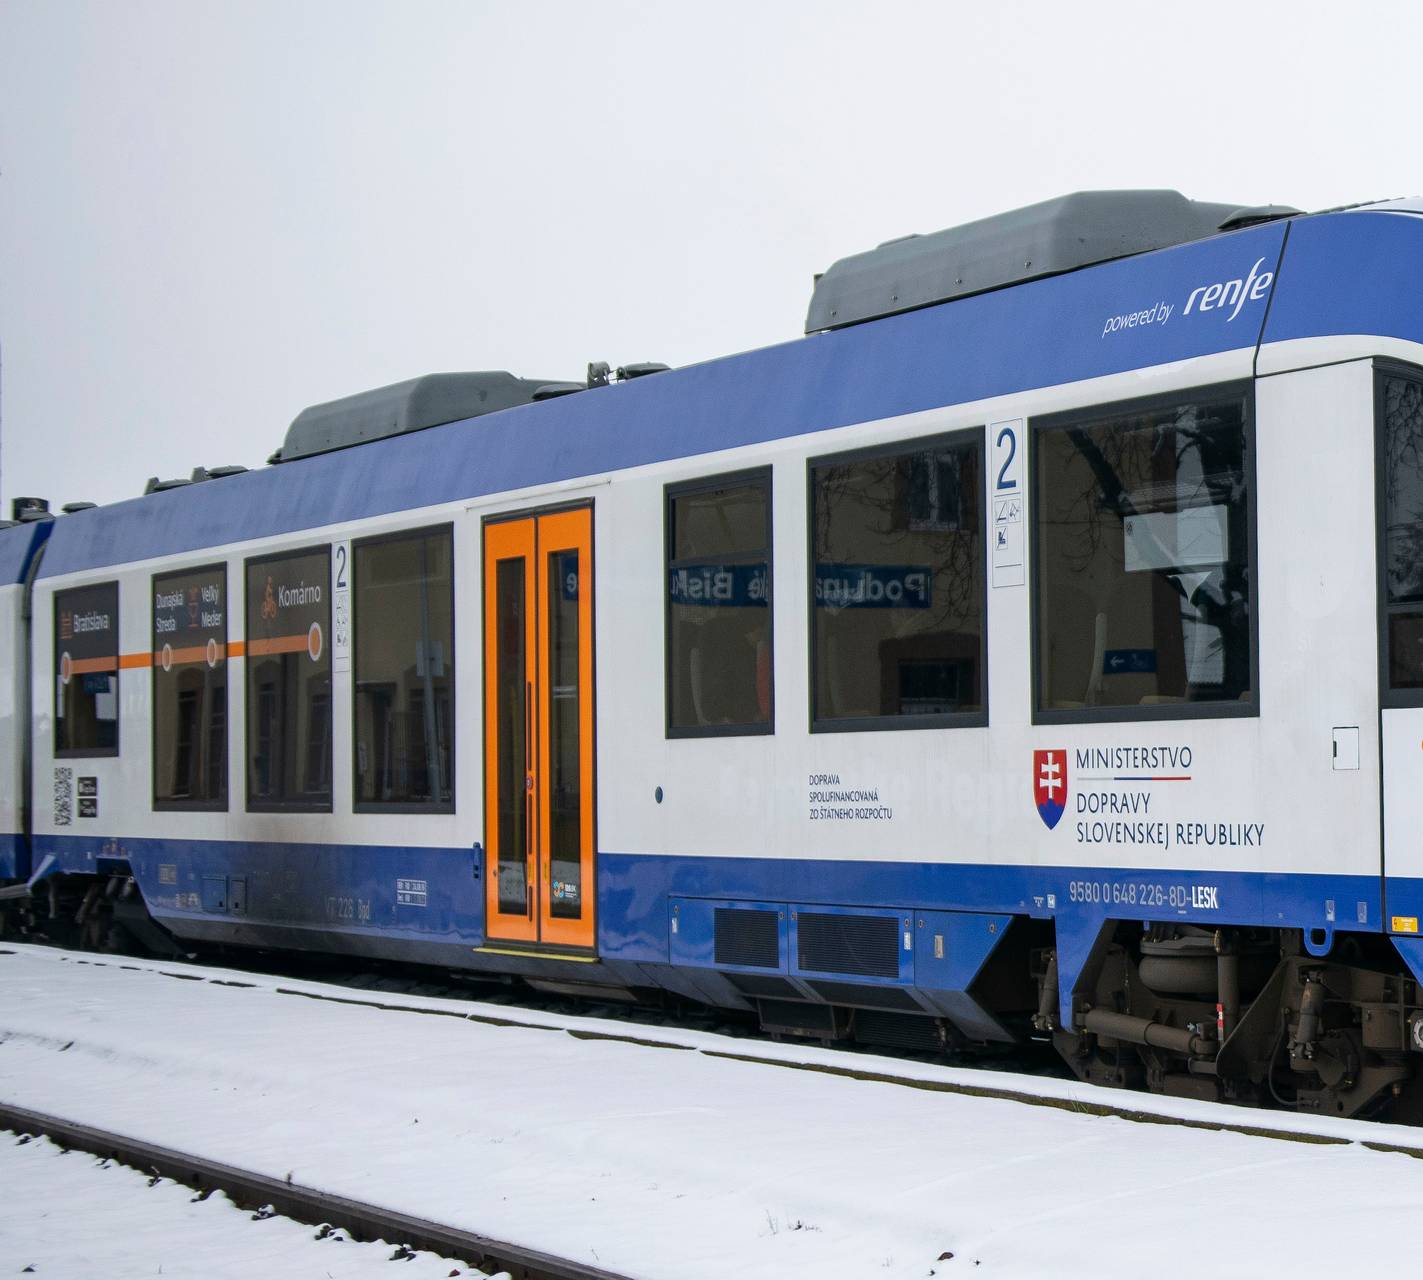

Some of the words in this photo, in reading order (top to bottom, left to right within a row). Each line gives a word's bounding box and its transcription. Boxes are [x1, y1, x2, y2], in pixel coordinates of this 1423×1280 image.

[1102, 303, 1159, 339] powered
[1156, 302, 1174, 325] by
[1183, 257, 1273, 322] renfe
[997, 427, 1016, 490] 2
[337, 546, 346, 588] 2
[278, 581, 321, 608] Komárno
[73, 611, 110, 633] Bratislava
[156, 617, 176, 633] Streda
[201, 610, 222, 628] Meder
[1076, 747, 1193, 769] MINISTERSTVO
[809, 774, 841, 786] DOPRAVA
[809, 787, 879, 803] SPOLUFINANCOVANÁ
[1077, 792, 1151, 814] DOPRAVY
[809, 808, 819, 820] ZO
[820, 806, 854, 820] ŠTÁTNEHO
[855, 805, 893, 820] ROZPOČTU
[1077, 822, 1169, 850] SLOVENSKEJ
[1176, 823, 1265, 846] REPUBLIKY
[1069, 881, 1099, 902] 9580
[1103, 883, 1110, 904] 0
[1113, 884, 1136, 905] 648
